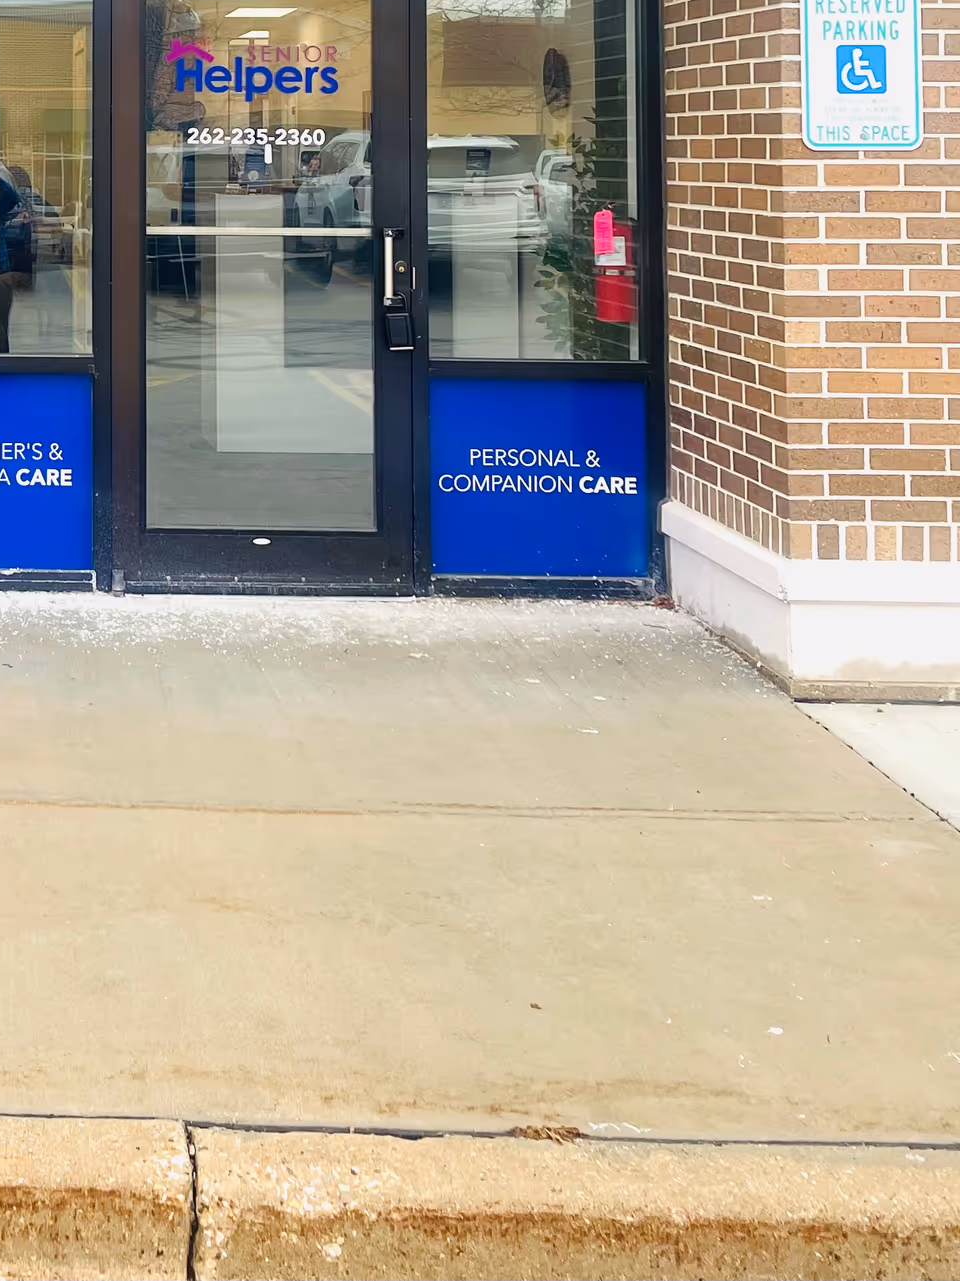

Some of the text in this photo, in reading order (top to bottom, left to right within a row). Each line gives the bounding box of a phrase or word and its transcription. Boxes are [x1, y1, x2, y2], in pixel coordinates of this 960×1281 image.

[822, 20, 900, 41] PARKING
[247, 45, 338, 62] SENIOR
[175, 56, 339, 102] Helpers
[187, 127, 326, 146] 262-235-2360
[816, 125, 910, 141] THIS SPACE
[48, 443, 64, 461] &
[470, 448, 601, 468] PERSONAL &
[15, 468, 73, 487] CARE
[438, 474, 638, 494] COMPANION CARE
